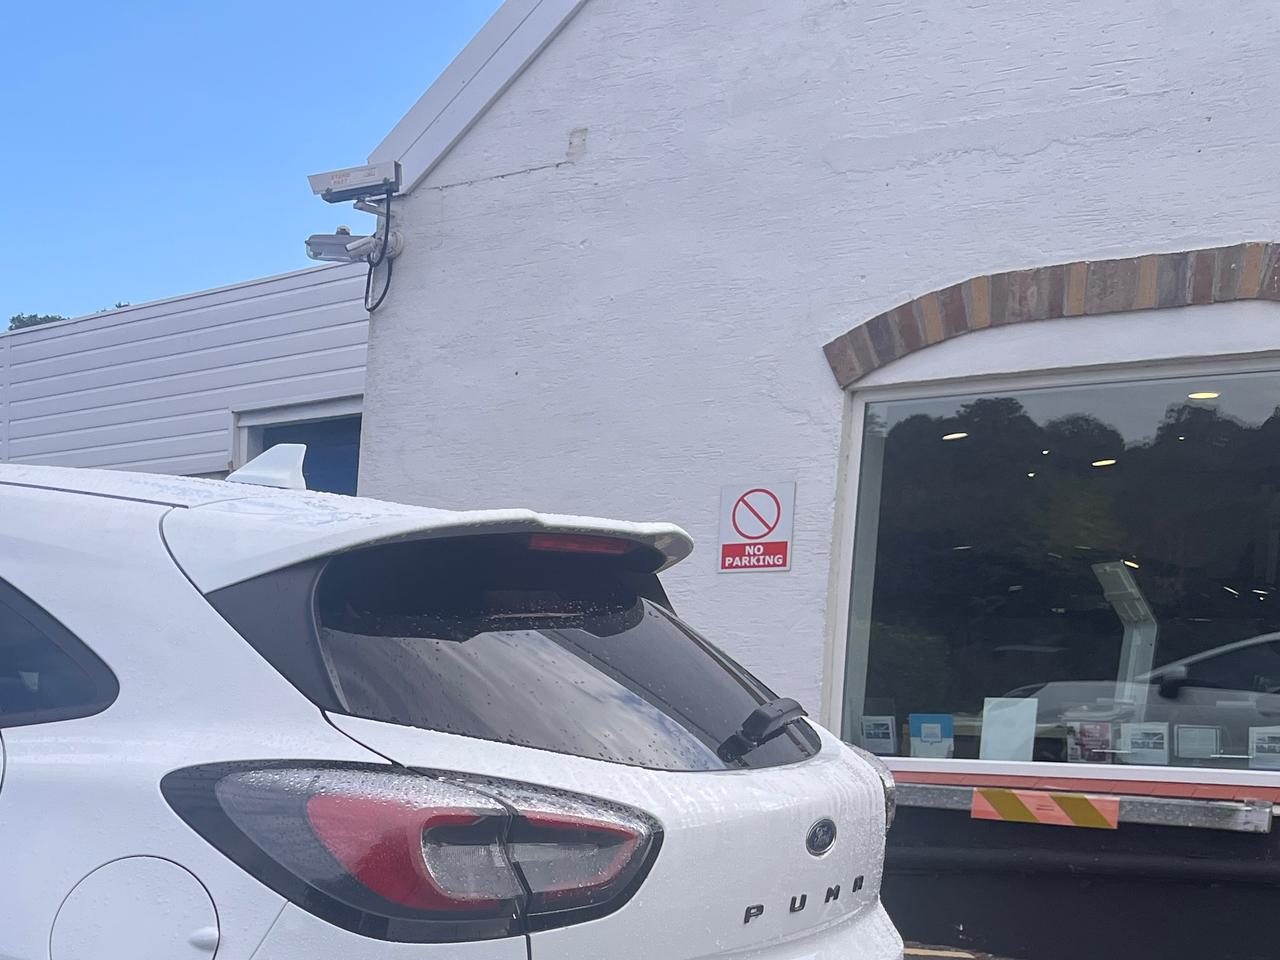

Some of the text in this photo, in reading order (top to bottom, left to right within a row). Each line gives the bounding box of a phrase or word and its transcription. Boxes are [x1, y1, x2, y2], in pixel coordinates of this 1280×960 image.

[745, 545, 764, 555] NO
[725, 555, 783, 567] PARKING
[744, 875, 864, 924] PUMA
